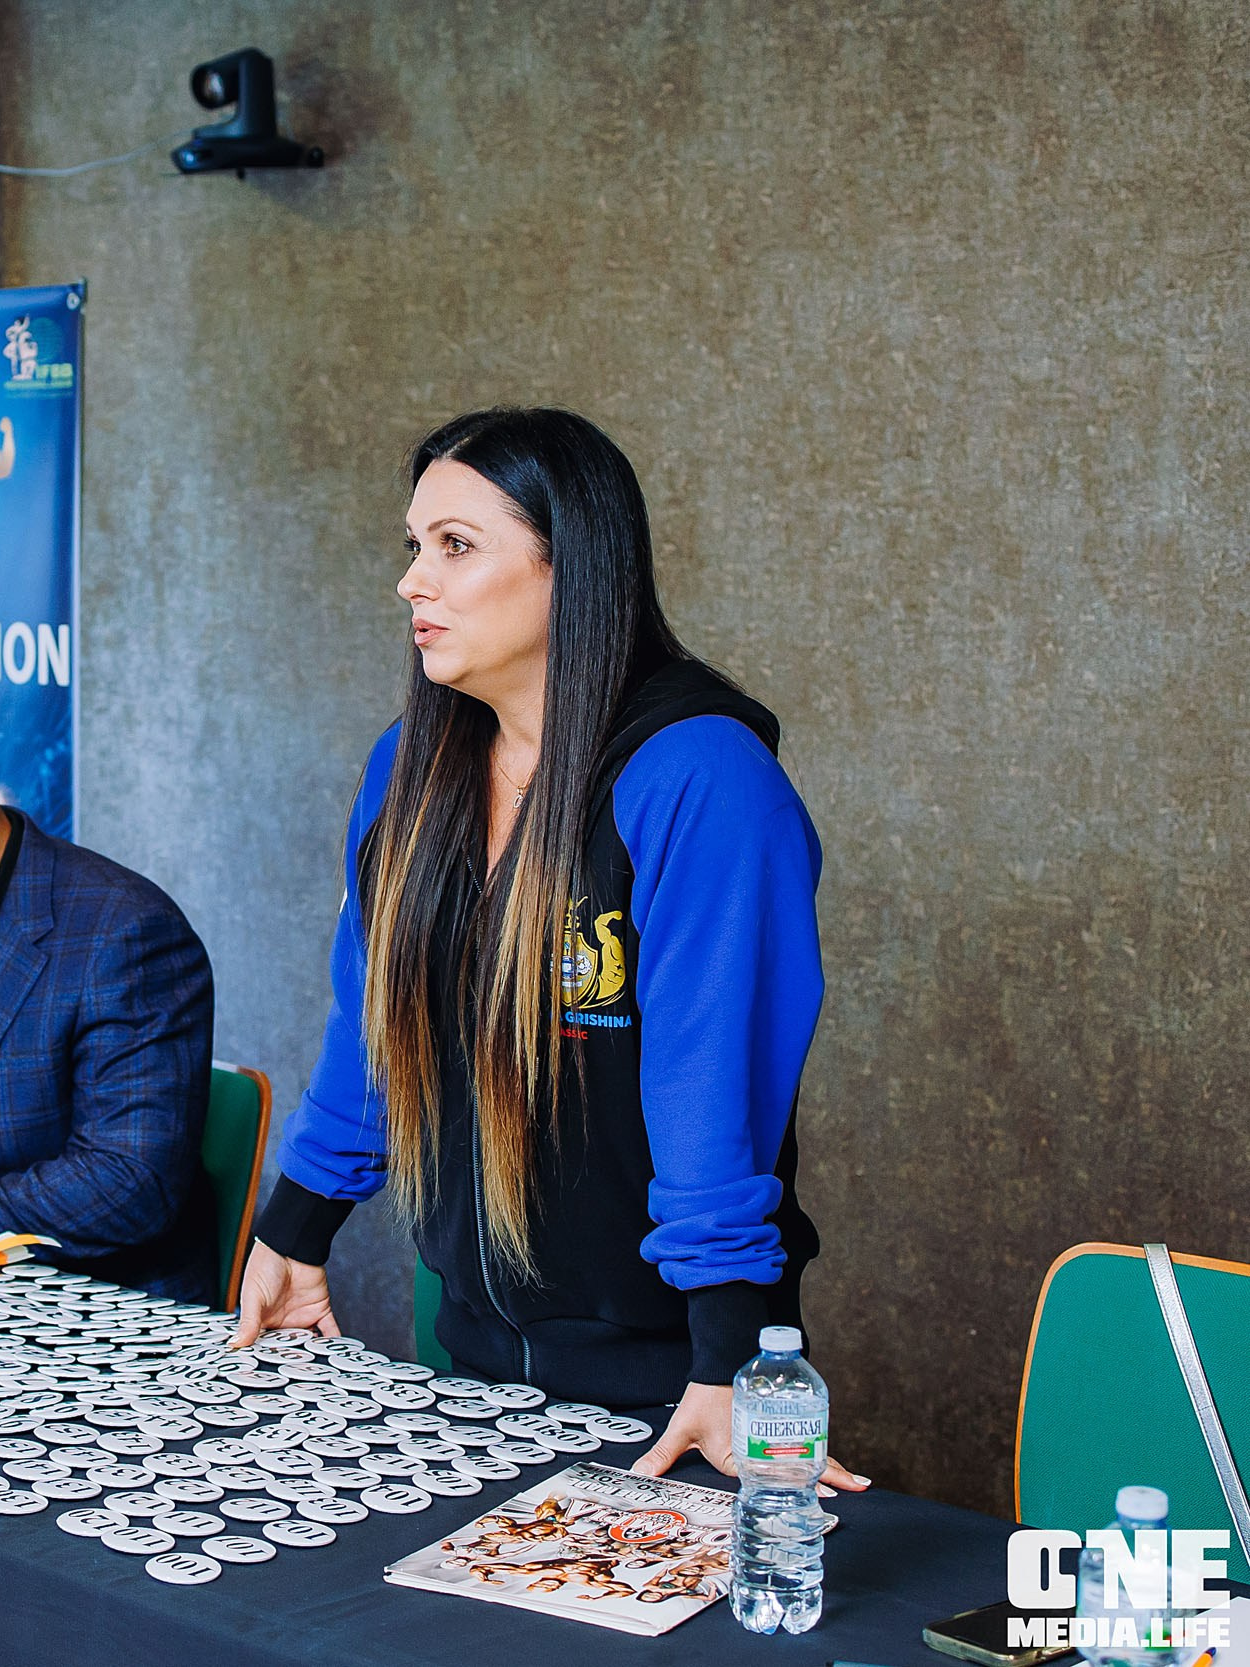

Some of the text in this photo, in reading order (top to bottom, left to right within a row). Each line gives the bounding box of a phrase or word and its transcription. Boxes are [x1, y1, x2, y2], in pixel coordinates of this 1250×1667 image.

[565, 1011, 632, 1028] GRISHINA
[559, 1029, 588, 1040] ASSIC
[162, 1365, 211, 1379] 96
[380, 1385, 431, 1403] 138
[488, 1387, 540, 1402] 129
[324, 1397, 375, 1414] 137
[556, 1405, 604, 1418] 119
[289, 1412, 340, 1430] 136
[504, 1415, 554, 1431] 118
[594, 1418, 647, 1438] 109
[750, 1420, 821, 1437] СЕНЕЖСКАЯ
[249, 1427, 302, 1441] 135
[540, 1429, 596, 1447] 108
[203, 1438, 253, 1458] 134
[409, 1440, 456, 1454] 116
[491, 1443, 549, 1458] 107
[153, 1455, 202, 1470] 133
[264, 1449, 313, 1469] 124
[367, 1455, 420, 1470] 115
[460, 1456, 513, 1474] 106
[12, 1461, 63, 1475] 141
[94, 1465, 147, 1480] 132
[216, 1467, 266, 1483] 123
[43, 1479, 94, 1493] 131
[422, 1471, 475, 1490] 105
[576, 1471, 625, 1485] 2015
[164, 1480, 216, 1496] 122
[368, 1485, 426, 1506] 104
[114, 1493, 167, 1510] 121
[230, 1500, 282, 1515] 112
[308, 1499, 360, 1517] 103
[69, 1510, 118, 1530] 120
[163, 1513, 214, 1528] 111
[113, 1528, 166, 1547] 110
[273, 1521, 328, 1540] 102
[214, 1537, 266, 1557] 101
[155, 1554, 213, 1577] 100
